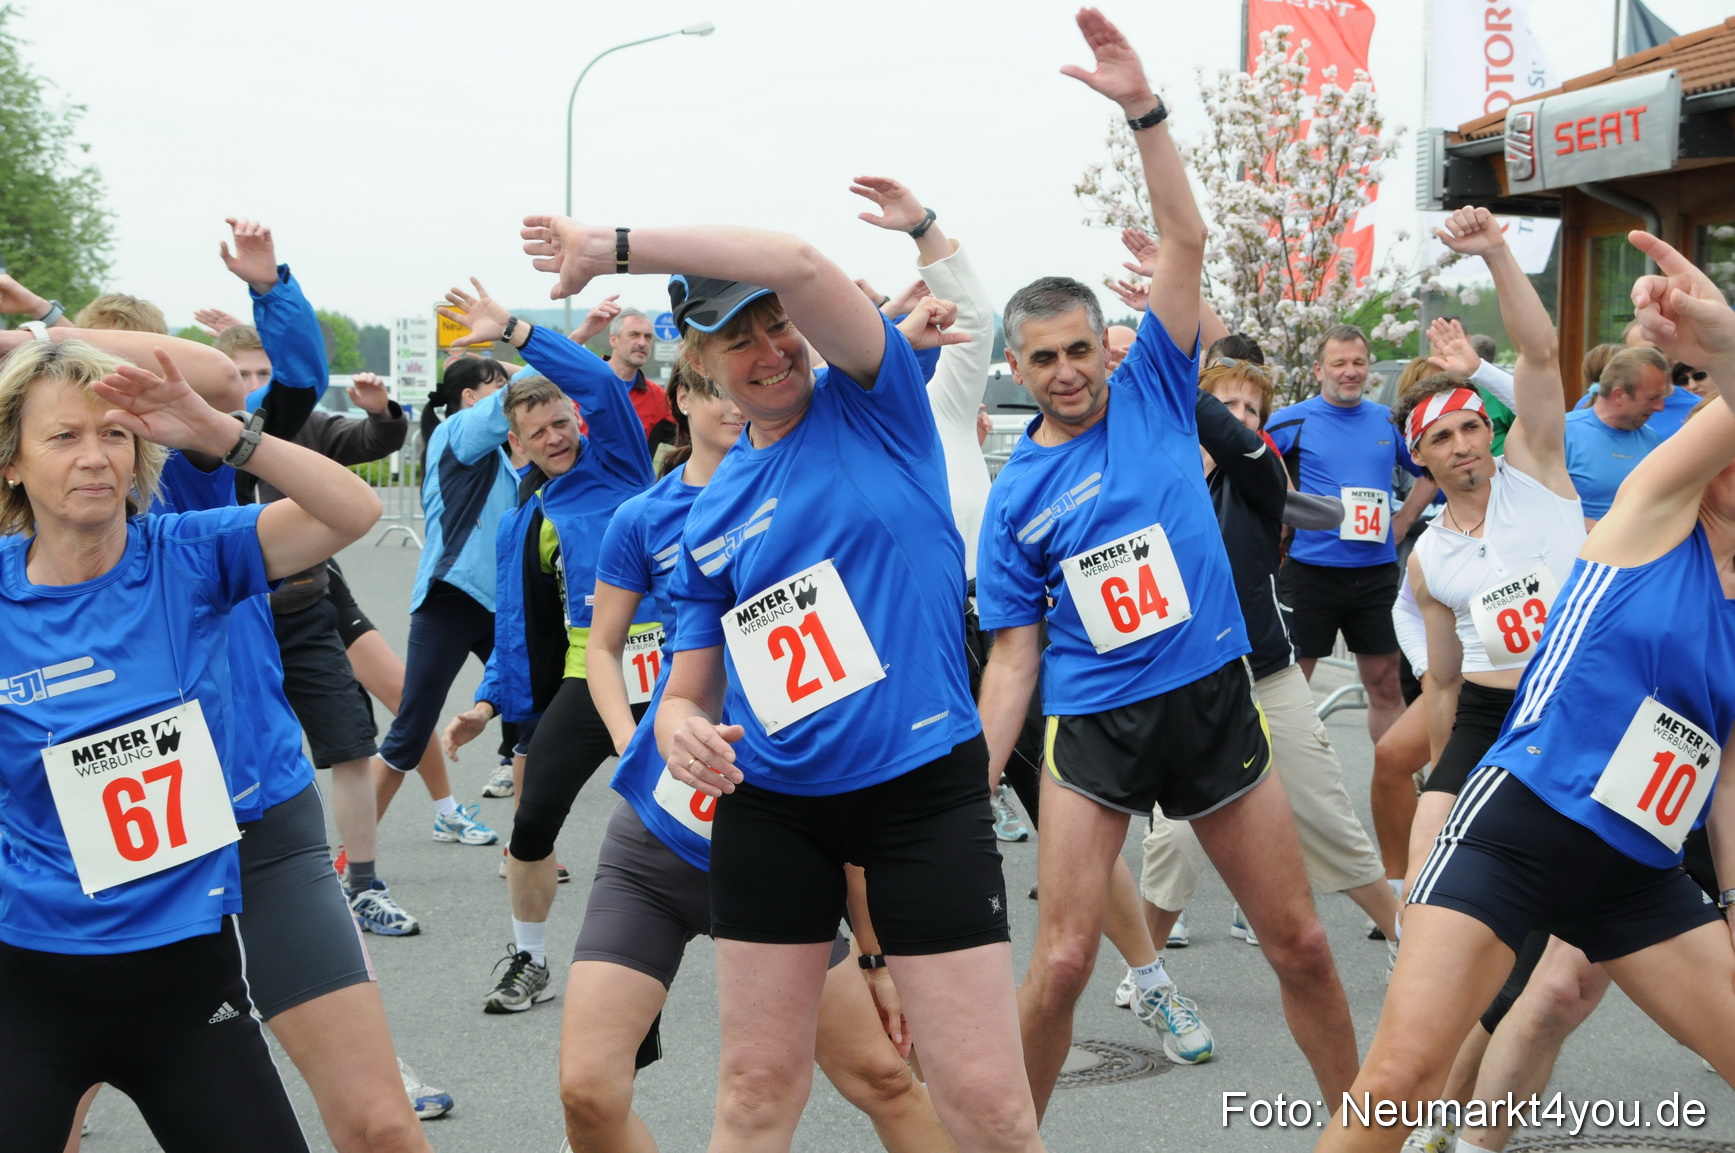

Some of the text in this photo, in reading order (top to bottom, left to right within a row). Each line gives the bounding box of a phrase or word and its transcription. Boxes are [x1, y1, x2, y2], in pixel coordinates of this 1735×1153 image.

[1262, 0, 1356, 17] EAT
[1484, 0, 1514, 115] OTOR
[1554, 105, 1647, 156] SEAT
[1354, 505, 1381, 536] 54
[1079, 543, 1128, 570] MEYER
[1082, 554, 1131, 578] WERBUNG
[737, 588, 789, 627] MEYER
[1101, 564, 1169, 634] 64
[1482, 581, 1522, 605] MEYER
[1484, 590, 1525, 611] WERBUNG
[741, 602, 794, 636] WERBUNG
[1496, 598, 1548, 654] 83
[632, 650, 660, 693] 11
[767, 611, 847, 703] 21
[72, 729, 149, 767] MEYER
[1653, 724, 1698, 759] WERBUNG
[1656, 712, 1704, 750] MEYER
[76, 745, 153, 778] WERBUNG
[1637, 750, 1697, 826] 10
[102, 759, 187, 862] 67
[208, 1010, 240, 1024] adidas
